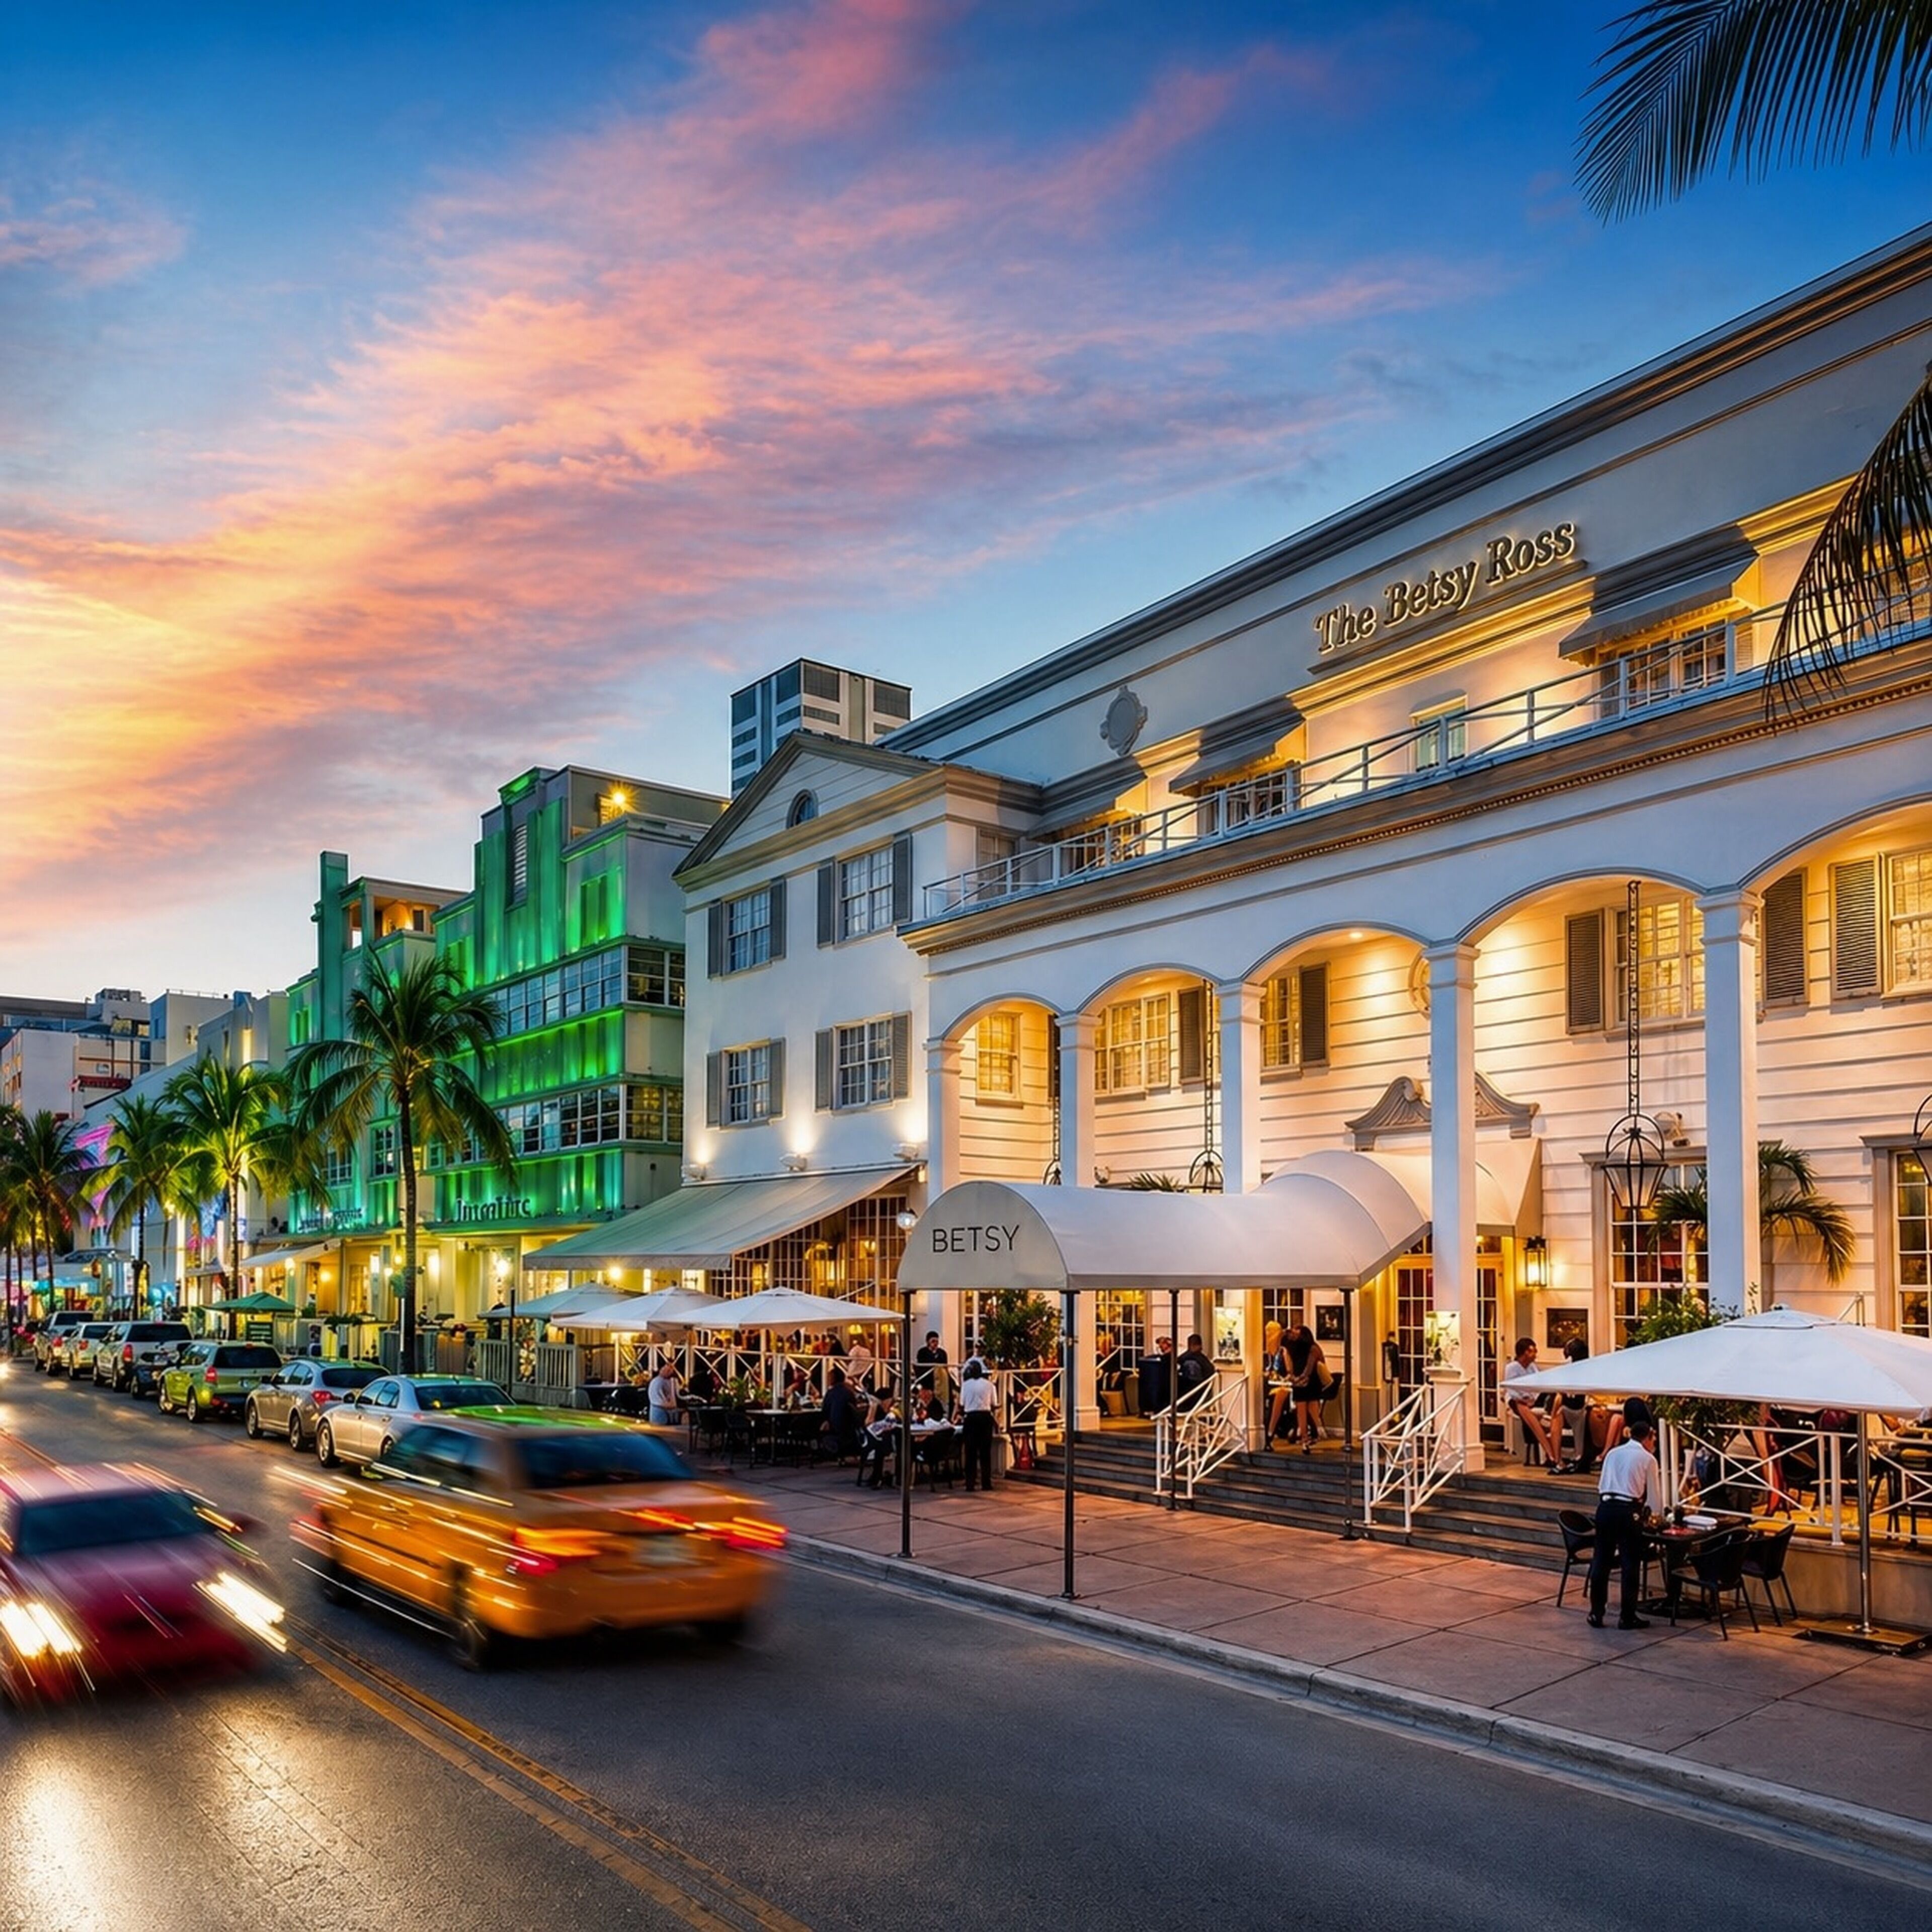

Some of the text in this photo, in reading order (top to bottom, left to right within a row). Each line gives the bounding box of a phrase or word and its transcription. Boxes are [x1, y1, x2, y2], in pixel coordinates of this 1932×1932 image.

[1315, 521, 1575, 654] The Betsy Ross
[933, 1225, 1020, 1253] BETSY
